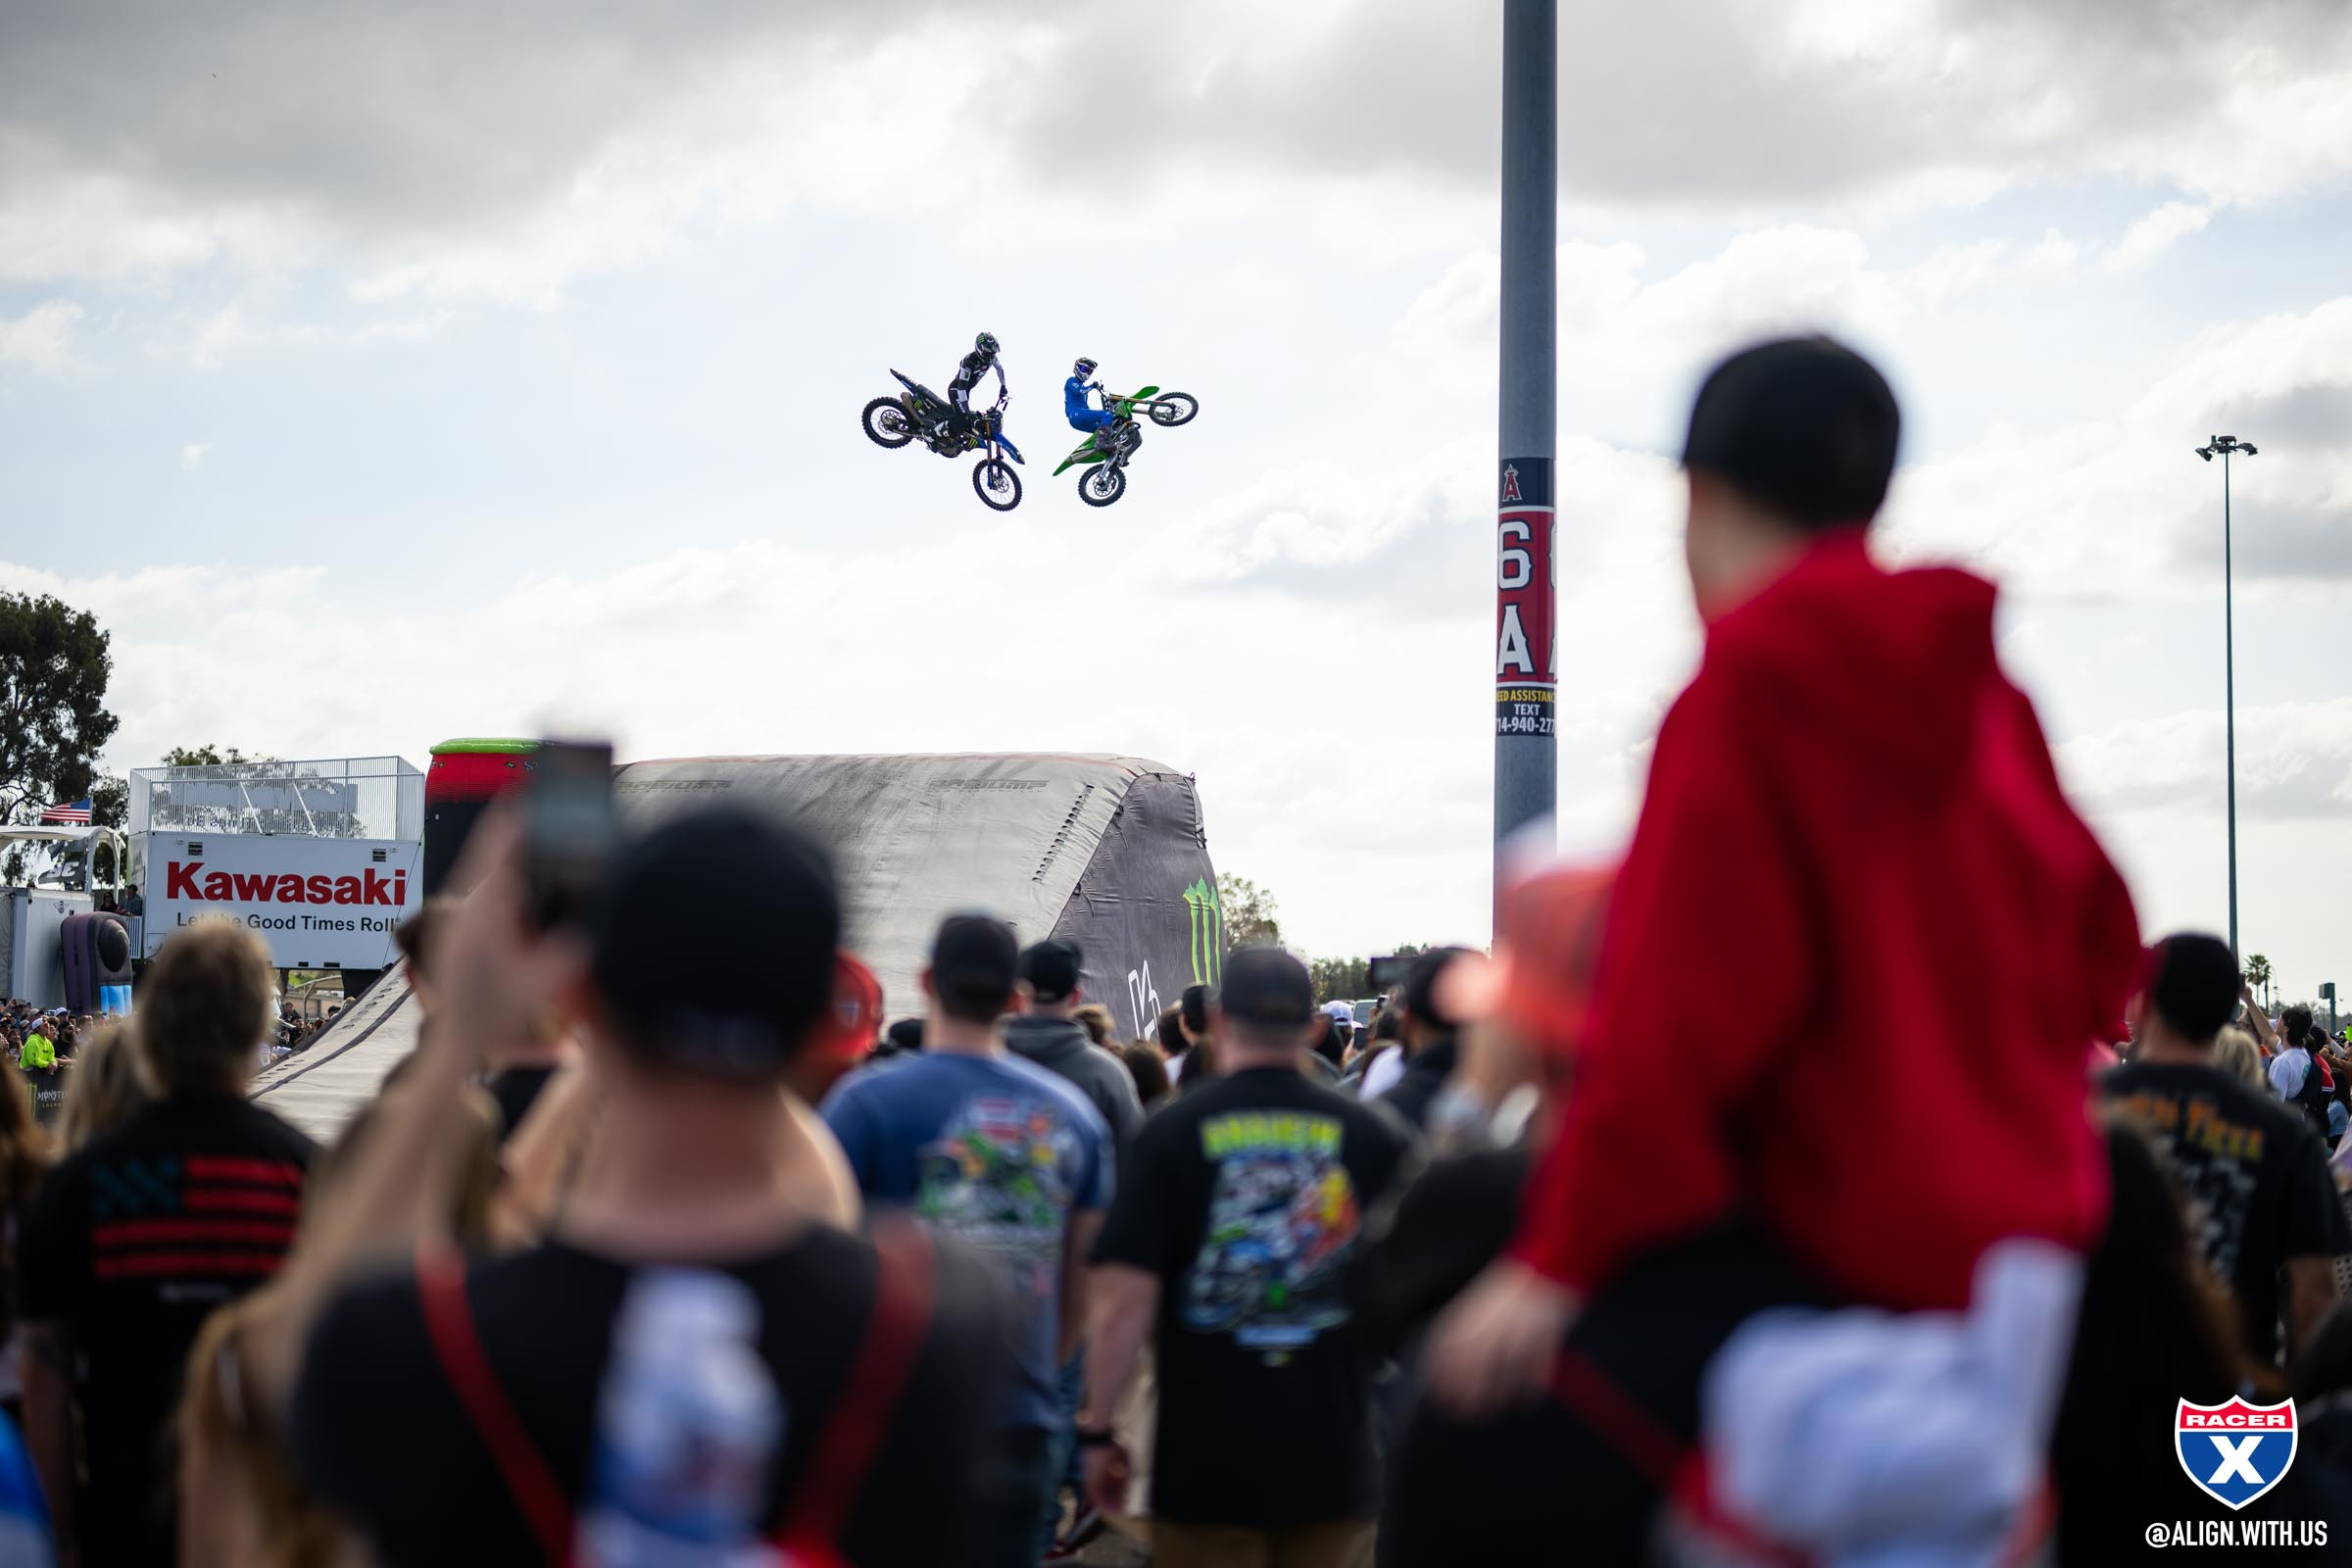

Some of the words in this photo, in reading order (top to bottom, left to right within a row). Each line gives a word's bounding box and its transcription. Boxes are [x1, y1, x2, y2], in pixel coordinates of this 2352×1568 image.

[1498, 519, 1532, 589] 6
[1497, 605, 1534, 674] A
[1496, 690, 1509, 703] EED
[1514, 704, 1541, 715] TEXT
[167, 861, 406, 906] Kawasaki
[247, 914, 296, 930] Good
[301, 915, 355, 931] Times
[37, 1089, 69, 1102] MONSTE
